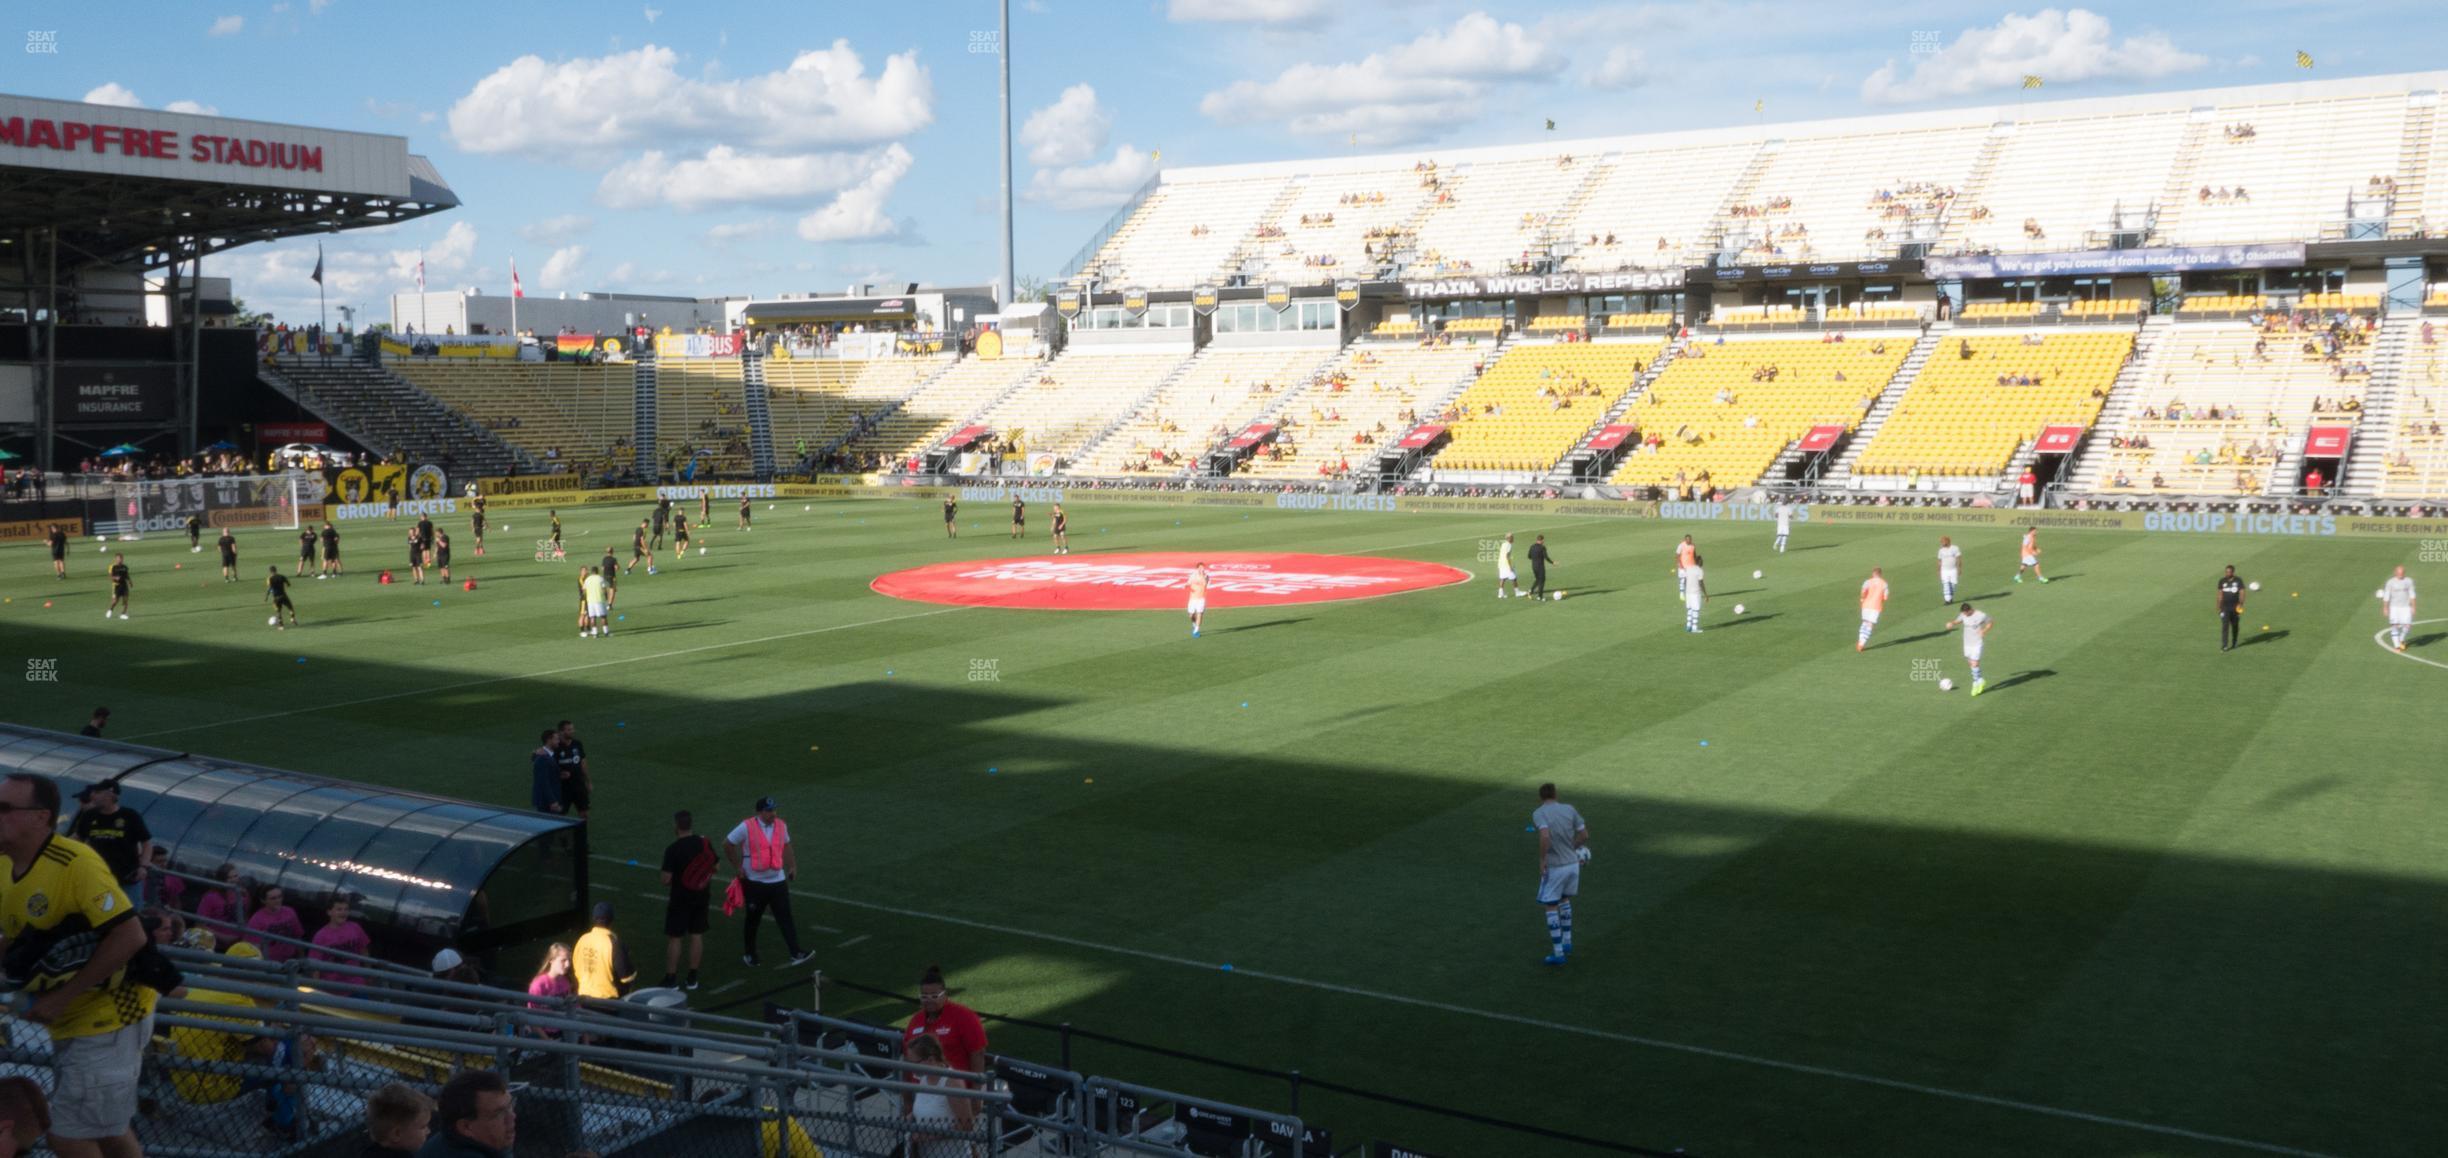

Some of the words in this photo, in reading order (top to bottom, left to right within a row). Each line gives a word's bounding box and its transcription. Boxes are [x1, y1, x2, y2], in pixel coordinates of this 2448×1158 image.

[0, 116, 179, 159] MAPFRE
[191, 134, 323, 173] STADIUM
[2000, 260, 2027, 271] We've
[2033, 261, 2051, 272] got
[2053, 260, 2073, 272] you
[2074, 257, 2116, 268] covered
[2118, 255, 2143, 267] from
[2145, 253, 2184, 265] header
[2186, 253, 2198, 263] to
[2200, 252, 2219, 263] toe
[2246, 250, 2300, 261] OhioHealth
[1945, 262, 1992, 273] OhioHealth
[1405, 281, 1480, 297] TRAIN.
[1487, 277, 1579, 294] MYOPLEX.
[1585, 272, 1681, 290] REPEAT.
[79, 384, 140, 395] MAPFRE
[78, 401, 143, 412] INSURANCE
[656, 486, 709, 500] GROUP
[712, 484, 775, 498] TICKETS
[961, 488, 1004, 500] GROUP
[1008, 488, 1064, 502] TICKETS
[336, 504, 389, 520] GROUP
[396, 498, 456, 516] TICKETS
[1277, 494, 1328, 508] GROUP
[1332, 496, 1396, 511] TICKETS
[1512, 504, 1544, 512] TICKETS
[1660, 502, 1723, 519] GROUP
[1728, 504, 1809, 522] TICKS
[1821, 510, 1853, 519] PRICES
[1856, 512, 1884, 520] BEGIN
[1886, 512, 1898, 520] AT
[1899, 512, 1910, 520] 20
[1927, 514, 1953, 522] MORE
[1956, 514, 1996, 523] TICKETS
[136, 514, 187, 531] adida
[2144, 513, 2226, 533] GROUP
[2232, 514, 2336, 536] TICKETS
[2352, 522, 2392, 533] PRICES
[2396, 524, 2431, 534] BEGIN
[2434, 524, 2448, 534] AT
[1120, 1096, 1135, 1108] 123
[1270, 1120, 1314, 1143] DAVA
